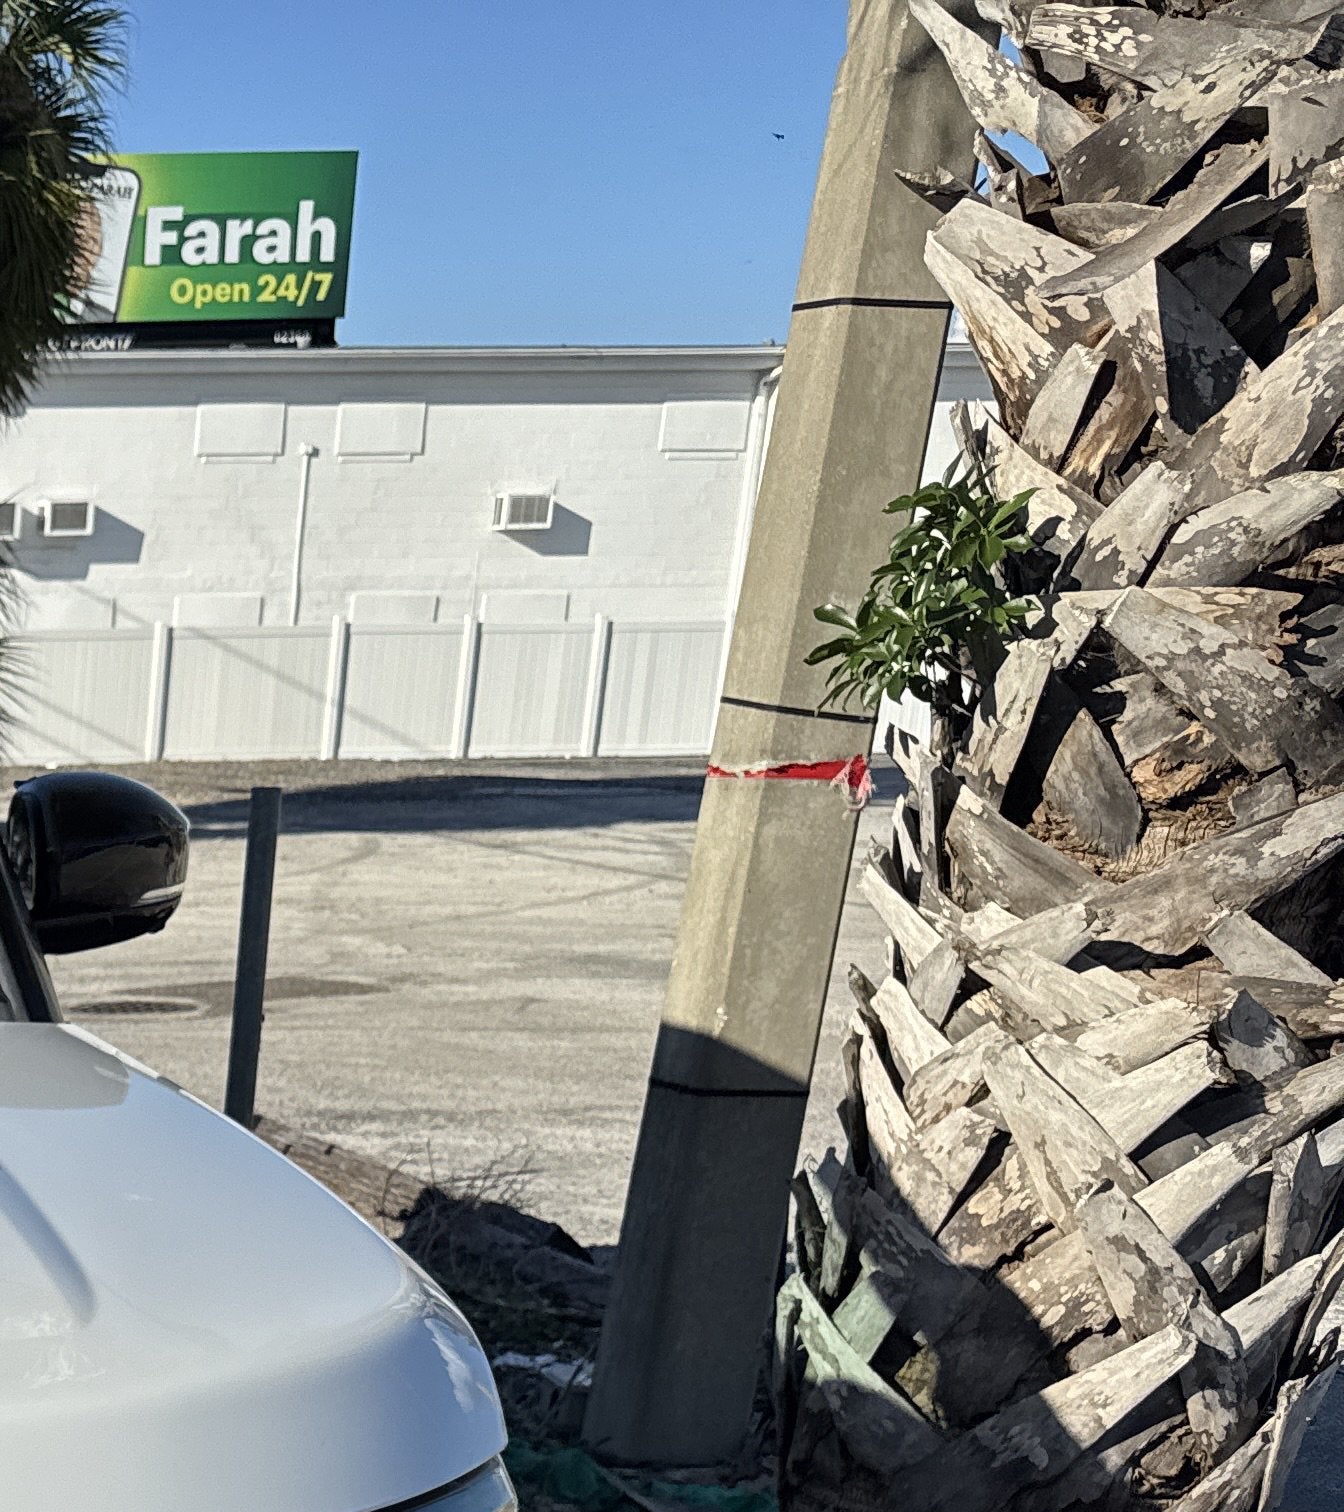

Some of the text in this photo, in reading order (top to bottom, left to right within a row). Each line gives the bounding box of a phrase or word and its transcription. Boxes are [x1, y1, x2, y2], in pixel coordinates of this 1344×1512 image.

[143, 199, 337, 266] Farah
[169, 270, 334, 309] Open 24/7
